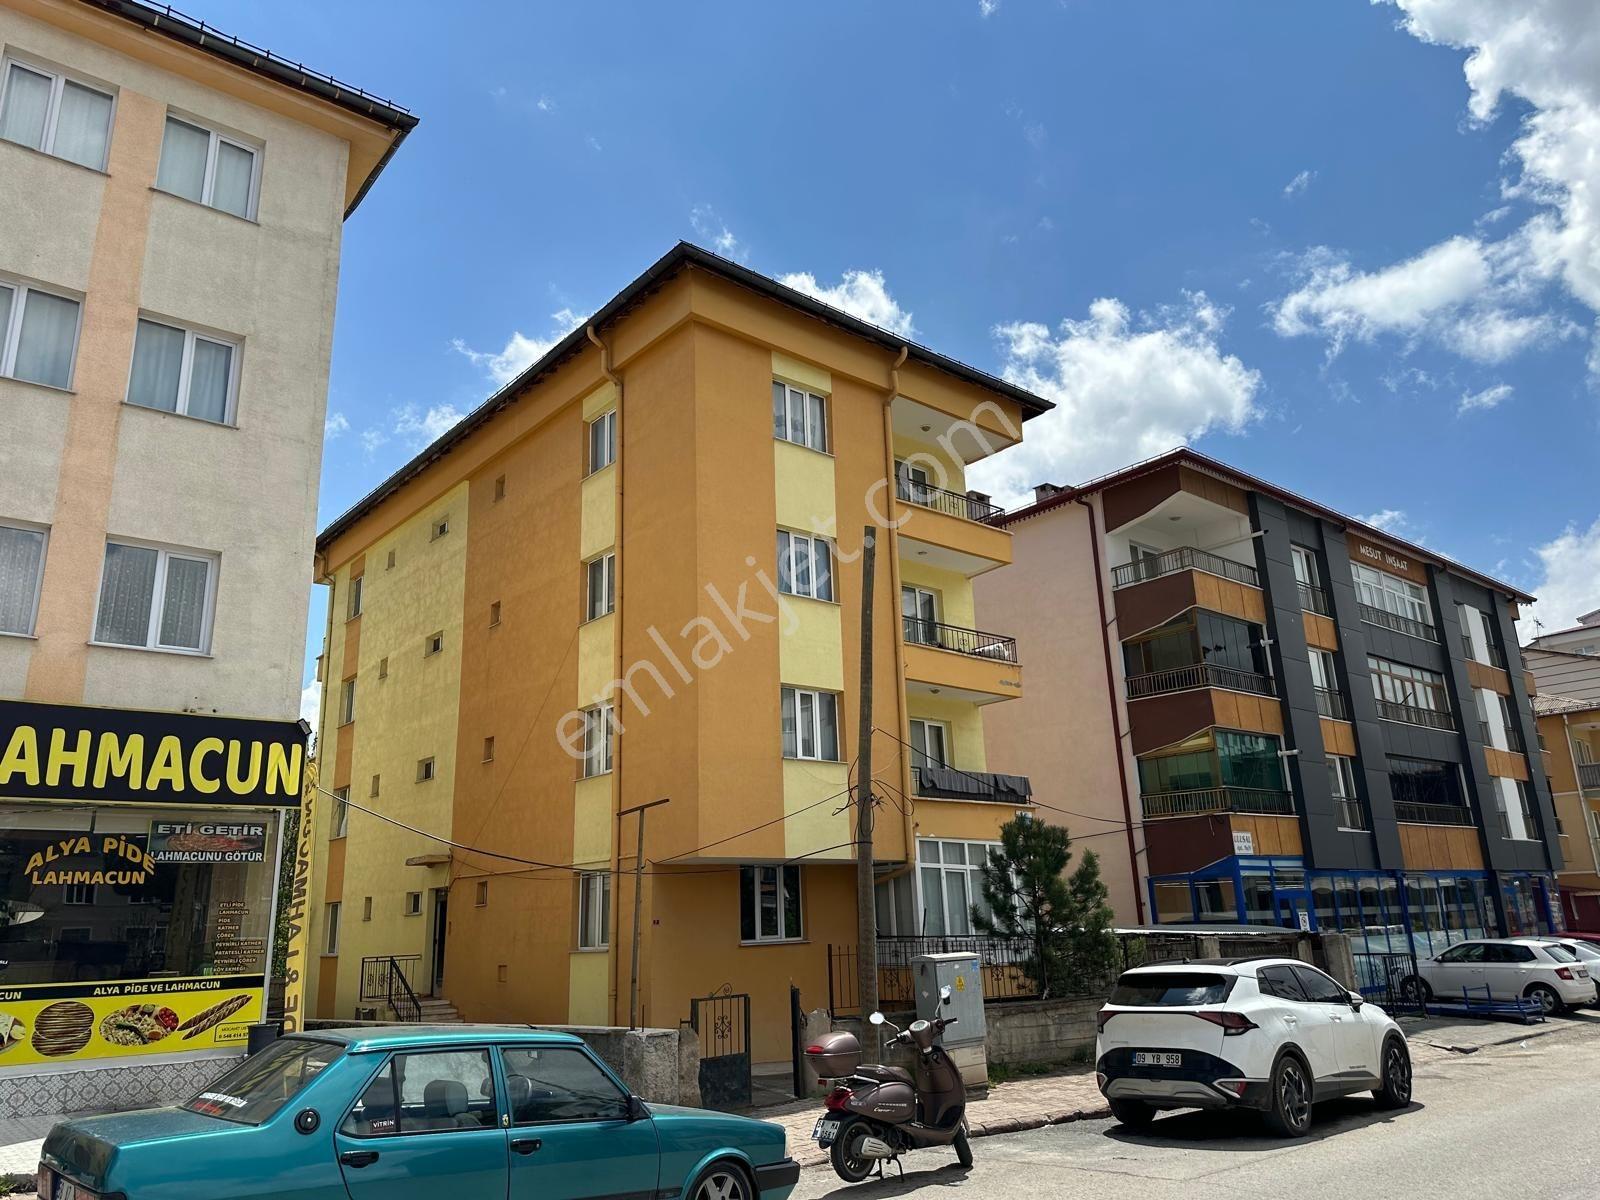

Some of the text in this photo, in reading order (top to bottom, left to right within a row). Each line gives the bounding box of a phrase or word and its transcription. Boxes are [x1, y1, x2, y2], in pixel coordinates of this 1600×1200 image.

[1360, 544, 1381, 560] MESUT
[157, 823, 264, 836] ETİ GETİR
[24, 835, 155, 876] ALYA PİDE
[151, 850, 263, 862] LAHMACUNU GÖTÜR
[32, 871, 145, 885] LAHMACUN
[94, 980, 221, 996] ALYA PİDE VE LAHMACUN
[1137, 1053, 1180, 1065] 09 YB 958
